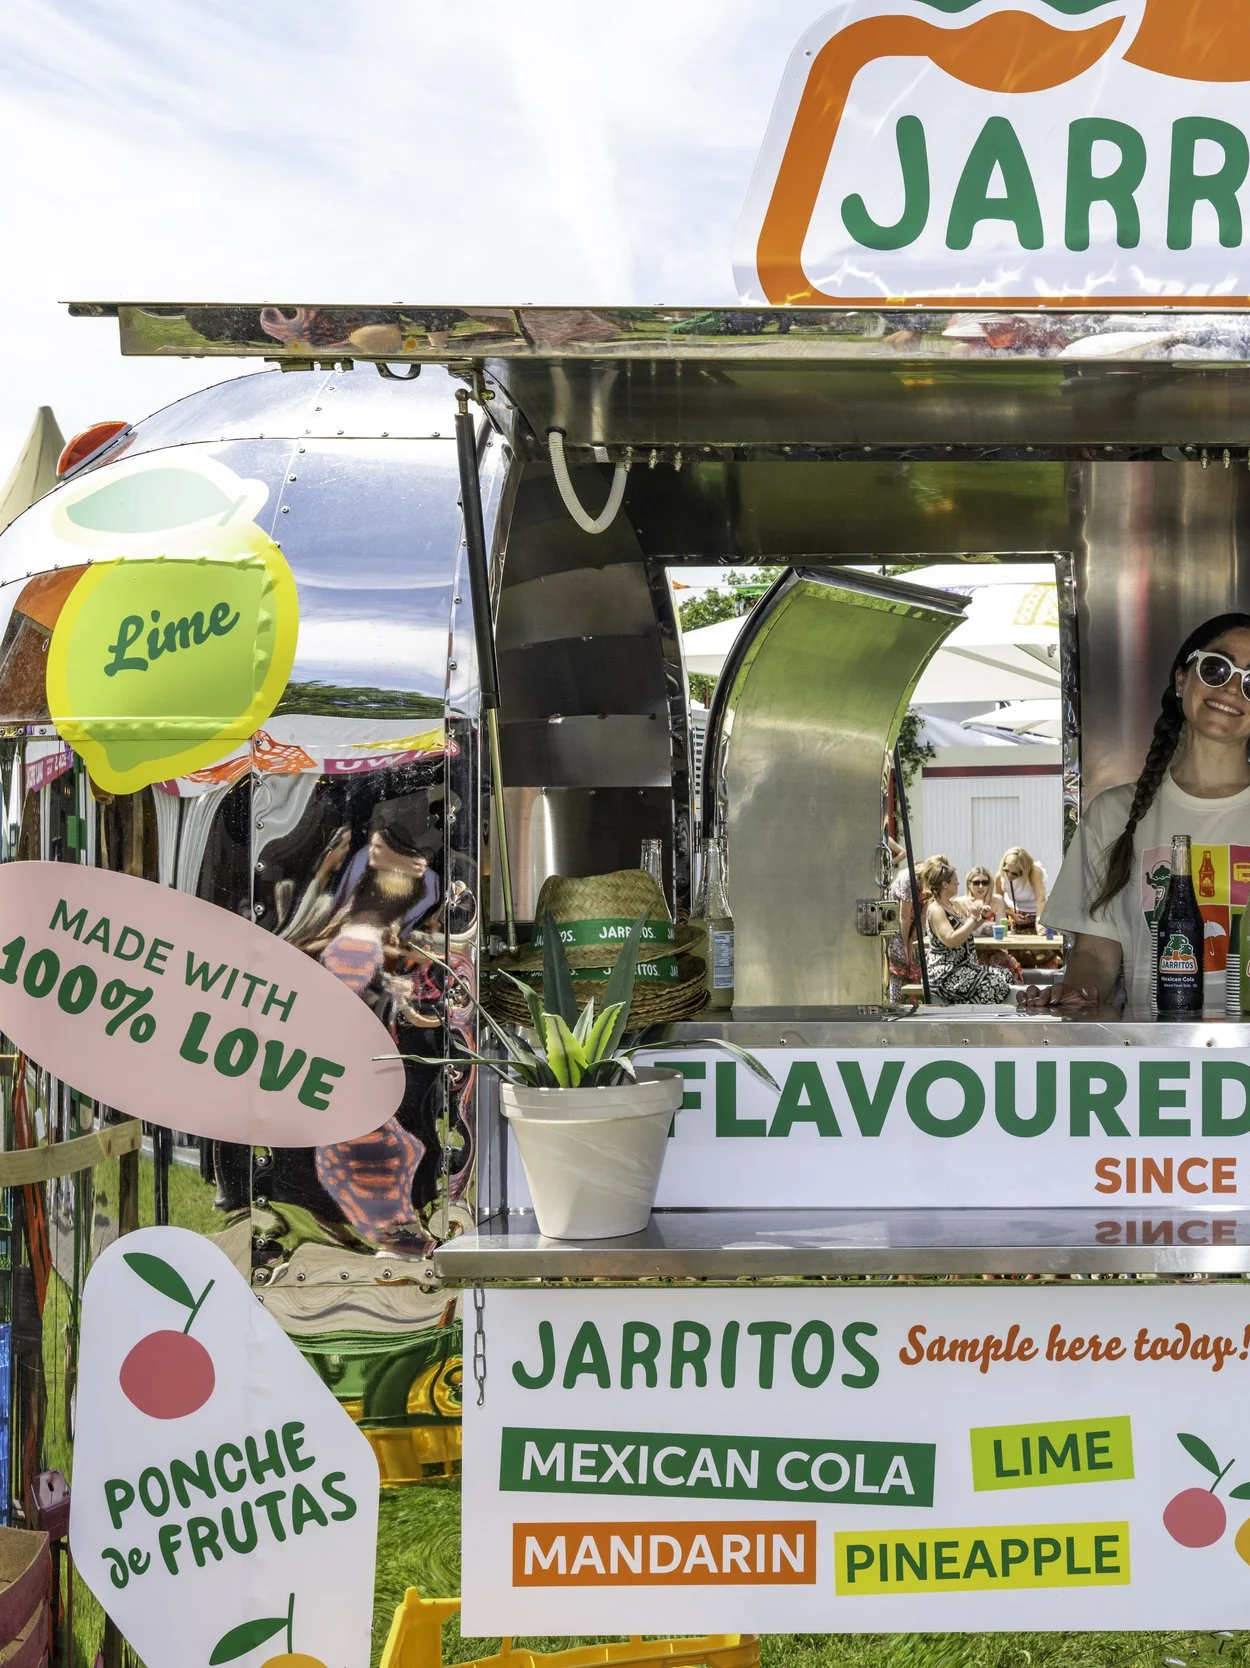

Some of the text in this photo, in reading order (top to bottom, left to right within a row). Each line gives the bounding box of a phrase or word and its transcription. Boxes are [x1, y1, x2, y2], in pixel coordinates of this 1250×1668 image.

[104, 602, 240, 677] Lime
[48, 898, 298, 1022] MADE WITH
[1161, 960, 1194, 970] JARRITOS
[0, 935, 346, 1111] 100% LOVE
[1095, 1157, 1237, 1193] SINCE
[512, 1320, 880, 1389] JARRITOS
[899, 1324, 1039, 1374] Sample
[1046, 1324, 1127, 1361] here
[104, 1421, 316, 1530] PONCHE
[521, 1441, 915, 1496] MEXICAN COLA
[993, 1430, 1113, 1478] LIME
[101, 1471, 357, 1589] de FRUTAS
[523, 1534, 806, 1575] MANDARIN
[845, 1534, 1121, 1584] PINEAPPLE
